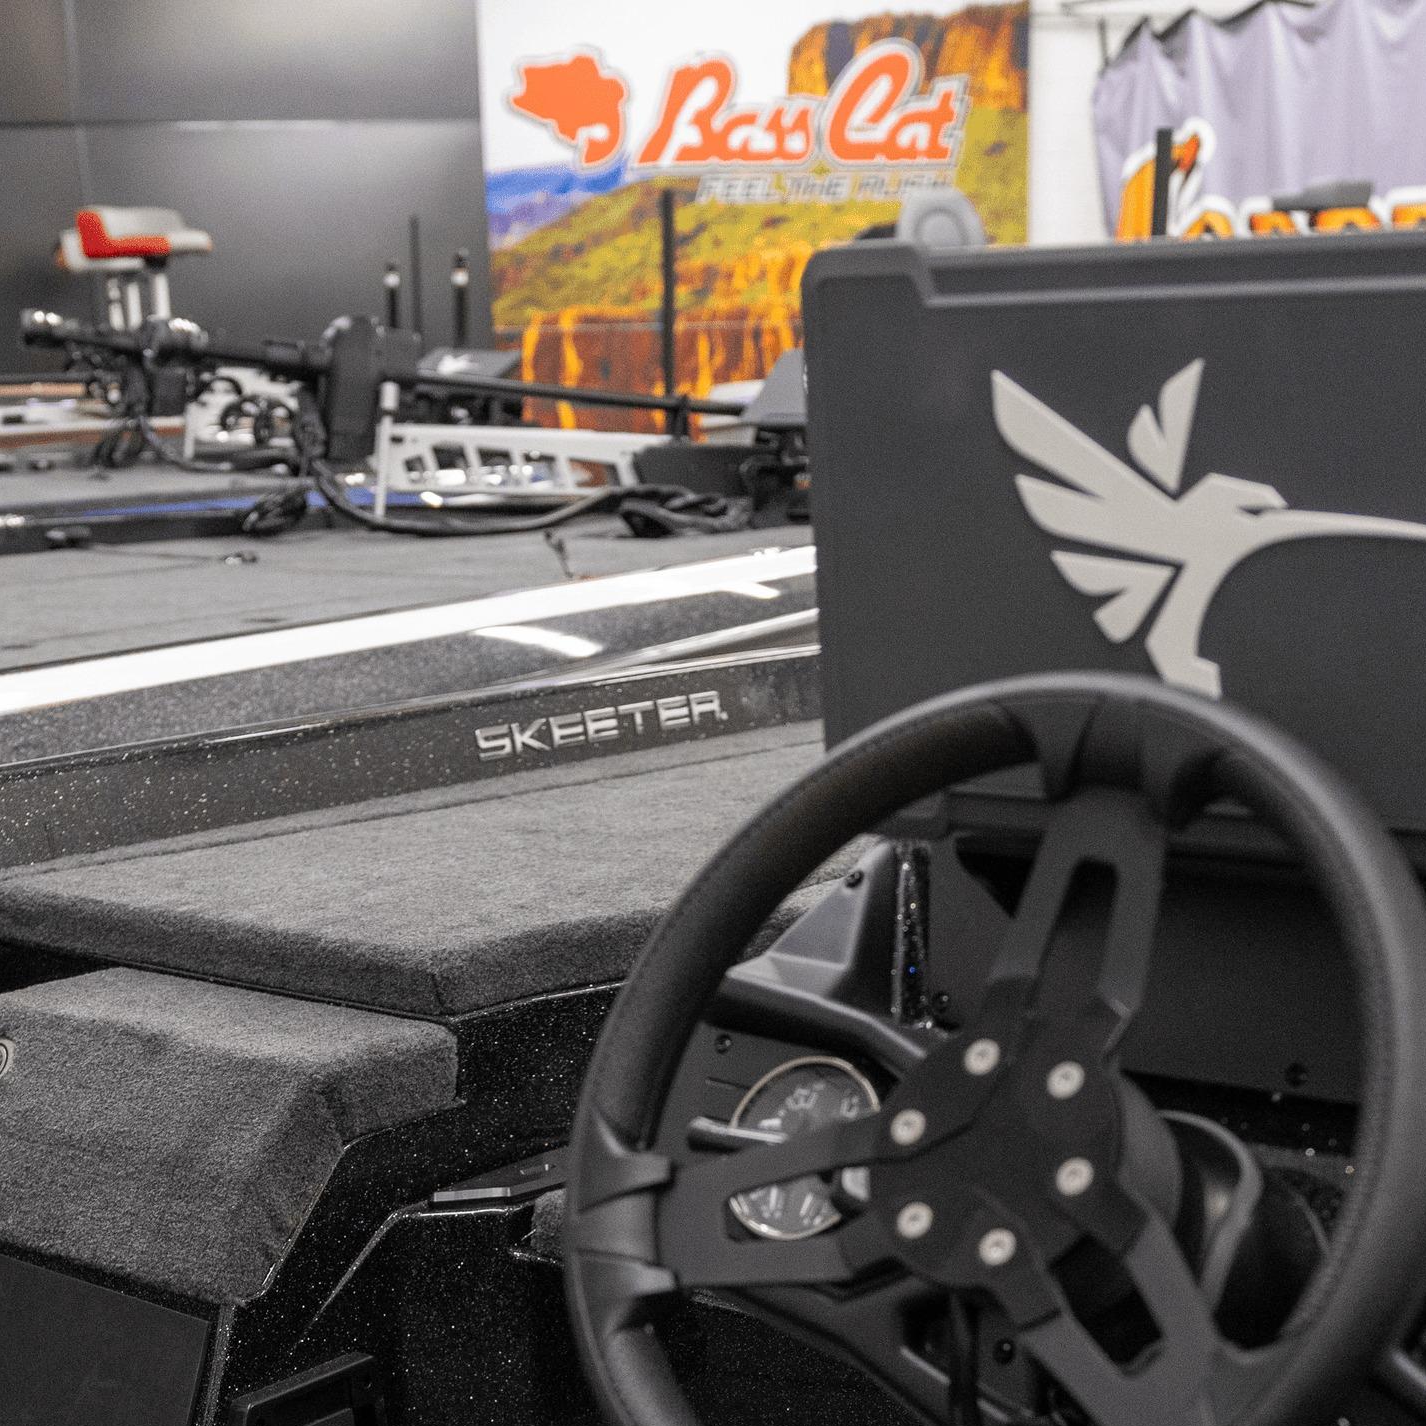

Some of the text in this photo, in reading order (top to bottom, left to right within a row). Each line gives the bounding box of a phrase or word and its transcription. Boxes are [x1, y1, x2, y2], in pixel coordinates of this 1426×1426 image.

[637, 52, 956, 165] Bass Cat
[474, 690, 725, 761] SKEETER
